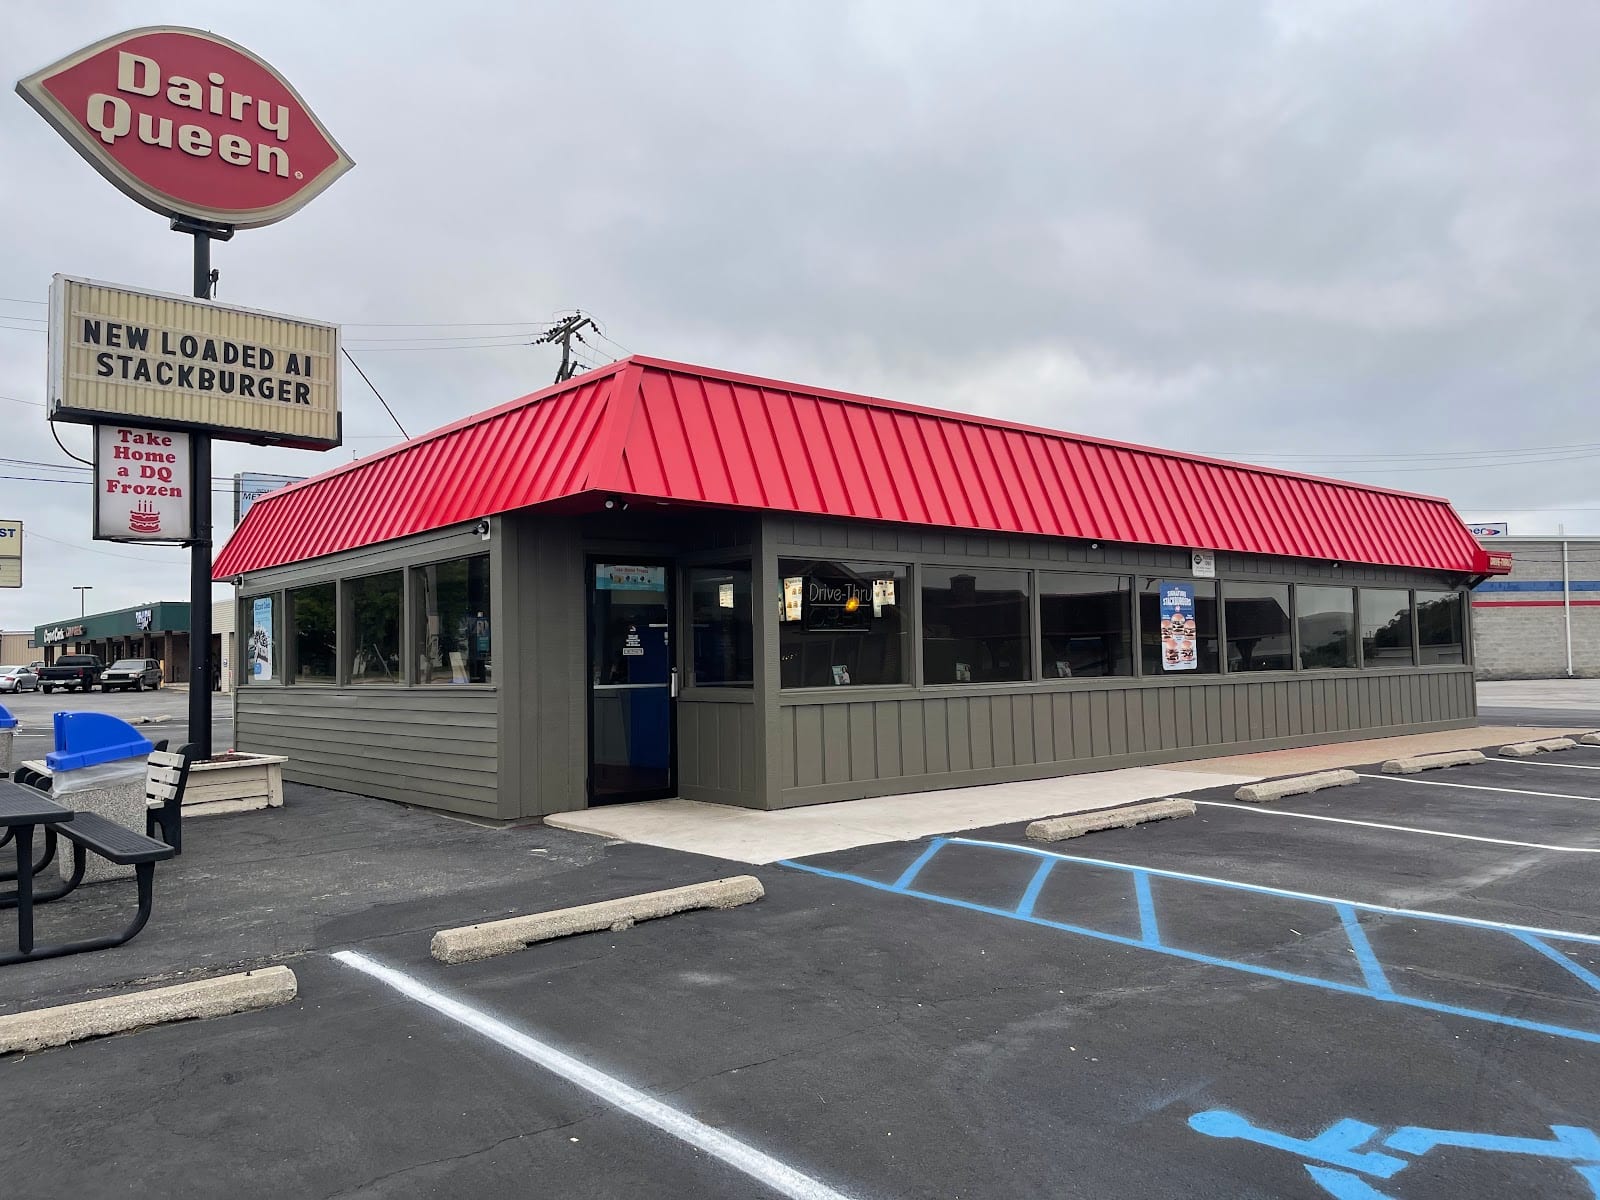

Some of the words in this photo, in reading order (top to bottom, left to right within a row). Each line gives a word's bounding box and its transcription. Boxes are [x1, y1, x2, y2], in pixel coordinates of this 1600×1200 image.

[117, 50, 290, 141] Dairy
[86, 92, 290, 178] Queen
[84, 319, 149, 351] NEW
[161, 331, 275, 370] LOADED
[97, 352, 311, 405] STACKBURGER
[117, 429, 172, 447] Take
[113, 445, 176, 464] Home
[117, 466, 129, 477] a
[140, 465, 173, 483] DQ
[106, 479, 182, 498] Frozen
[808, 582, 873, 603] Drive-Thru
